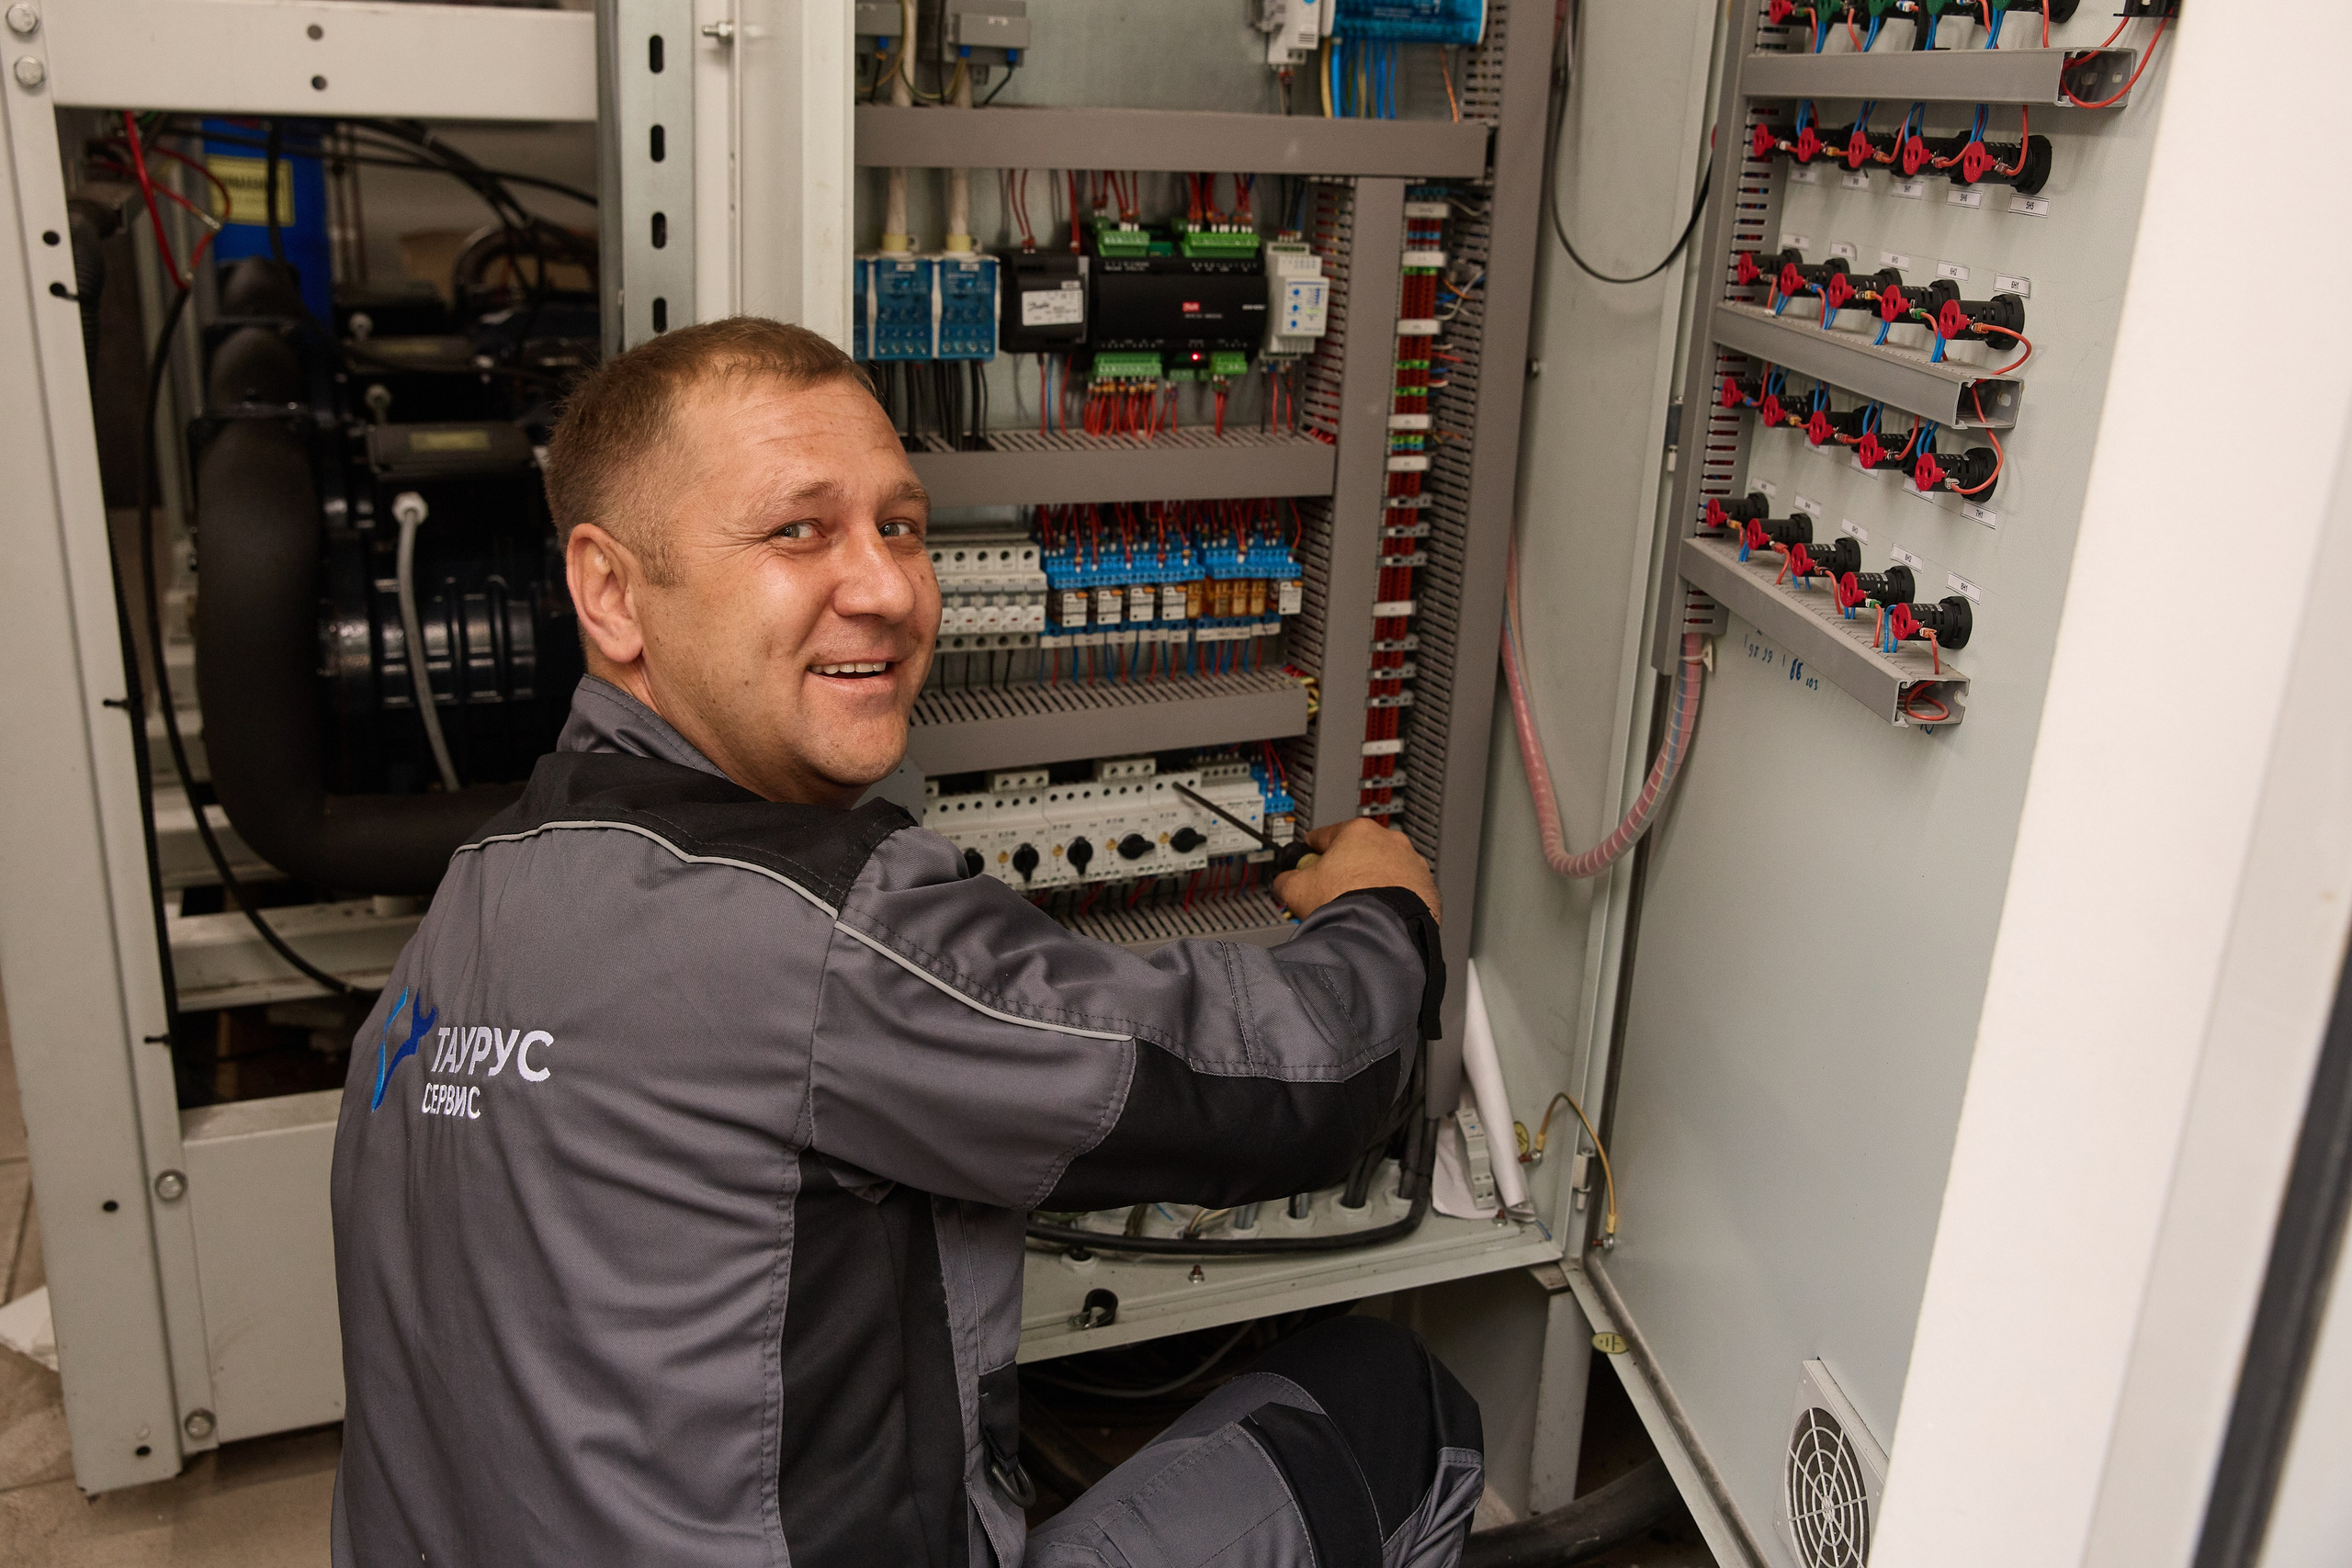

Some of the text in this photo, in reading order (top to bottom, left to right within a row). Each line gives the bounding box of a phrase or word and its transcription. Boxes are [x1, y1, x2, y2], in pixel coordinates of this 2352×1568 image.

[2026, 200, 2034, 210] 5H5
[2011, 281, 2019, 289] 6H1
[1975, 509, 1984, 519] 7H1
[431, 1026, 555, 1082] ТАУРУС
[421, 1082, 481, 1120] СЕРВИС
